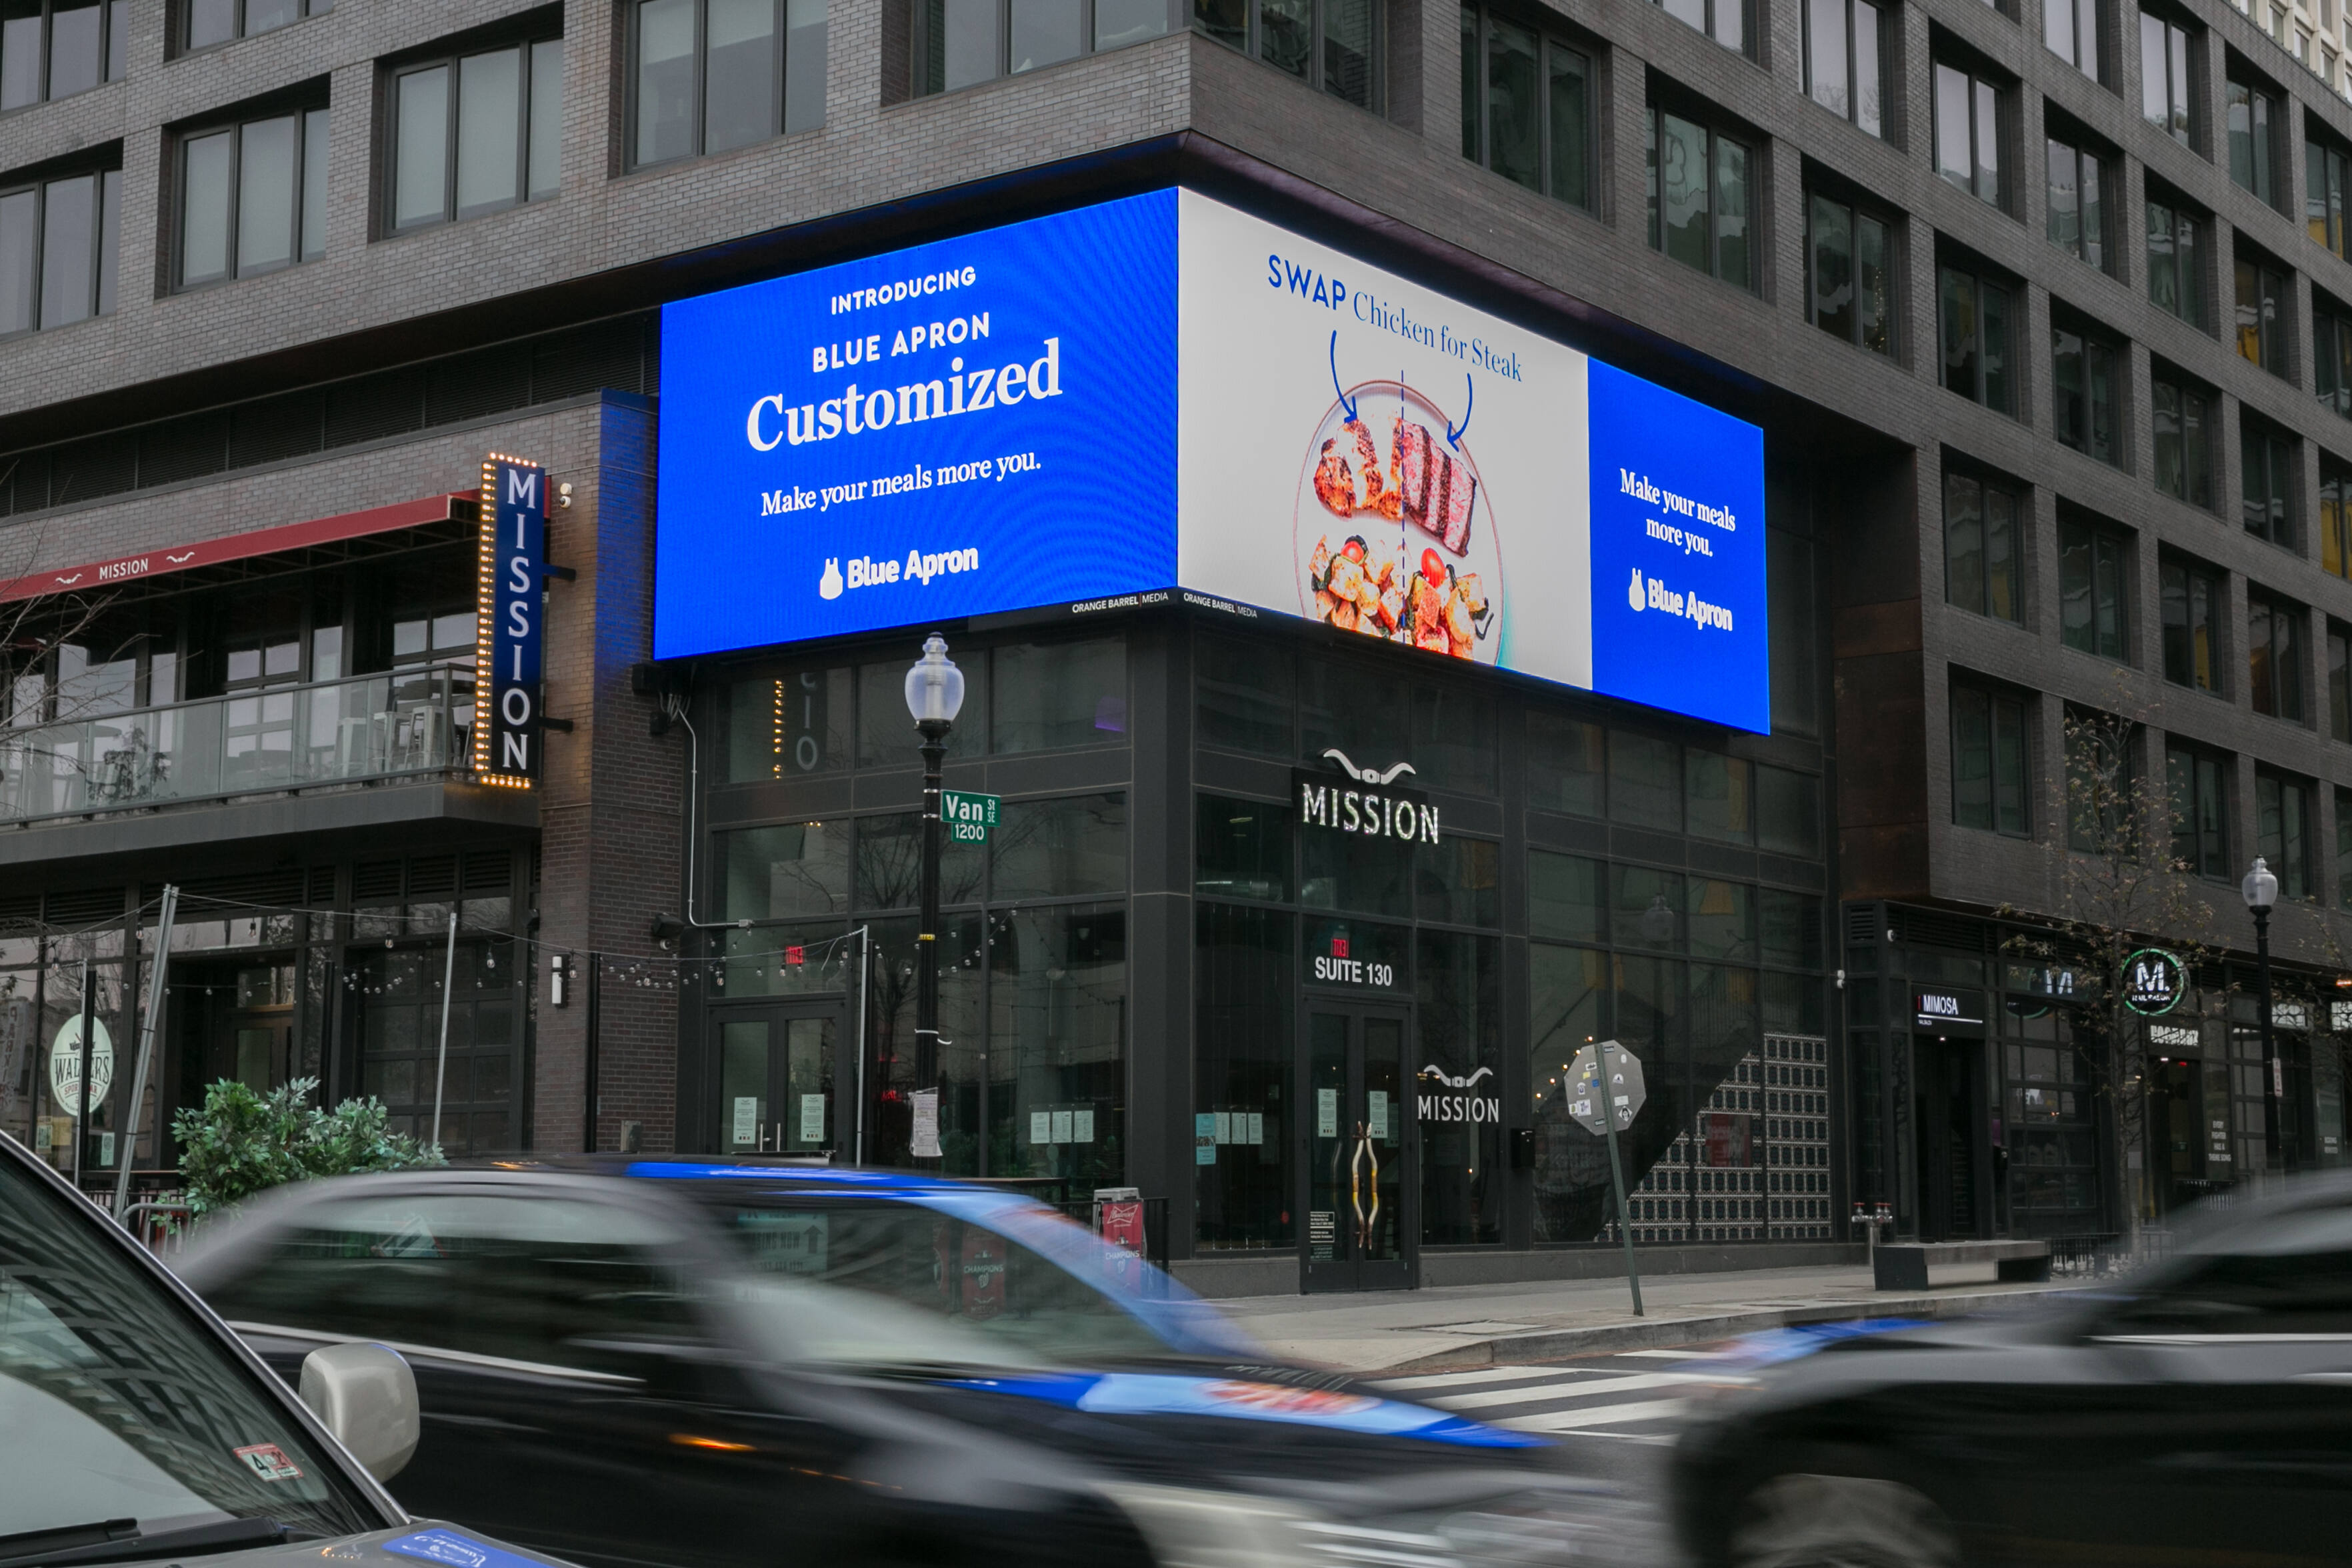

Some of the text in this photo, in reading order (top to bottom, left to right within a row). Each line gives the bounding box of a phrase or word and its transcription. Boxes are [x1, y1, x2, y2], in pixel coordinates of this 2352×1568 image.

[831, 265, 976, 315] INTRODUCING
[1268, 255, 1523, 383] SWAP Chicken for Steak
[813, 312, 990, 373] BLUE APRON
[747, 337, 1063, 451] Customized
[761, 451, 1041, 517] Make your meals more you.
[1620, 468, 1736, 531] Make your meals
[1646, 519, 1713, 557] more you.
[99, 558, 149, 580] MISSION
[848, 547, 978, 589] Blue Apron
[502, 469, 537, 770] MISSION
[1072, 592, 1169, 613] ORANGE BARREL MEDIA
[1183, 592, 1257, 618] ORANGE BARREL MEDIA
[1648, 578, 1733, 631] Blue Apron
[945, 794, 995, 821] Van St
[987, 811, 995, 823] SE
[1303, 783, 1439, 844] MISSION
[955, 823, 985, 840] 1200
[1315, 956, 1392, 986] SUITE 130
[1923, 994, 1959, 1015] MIMOSA
[1418, 1095, 1499, 1123] MISSION
[963, 1263, 1003, 1274] CHAMPIONS
